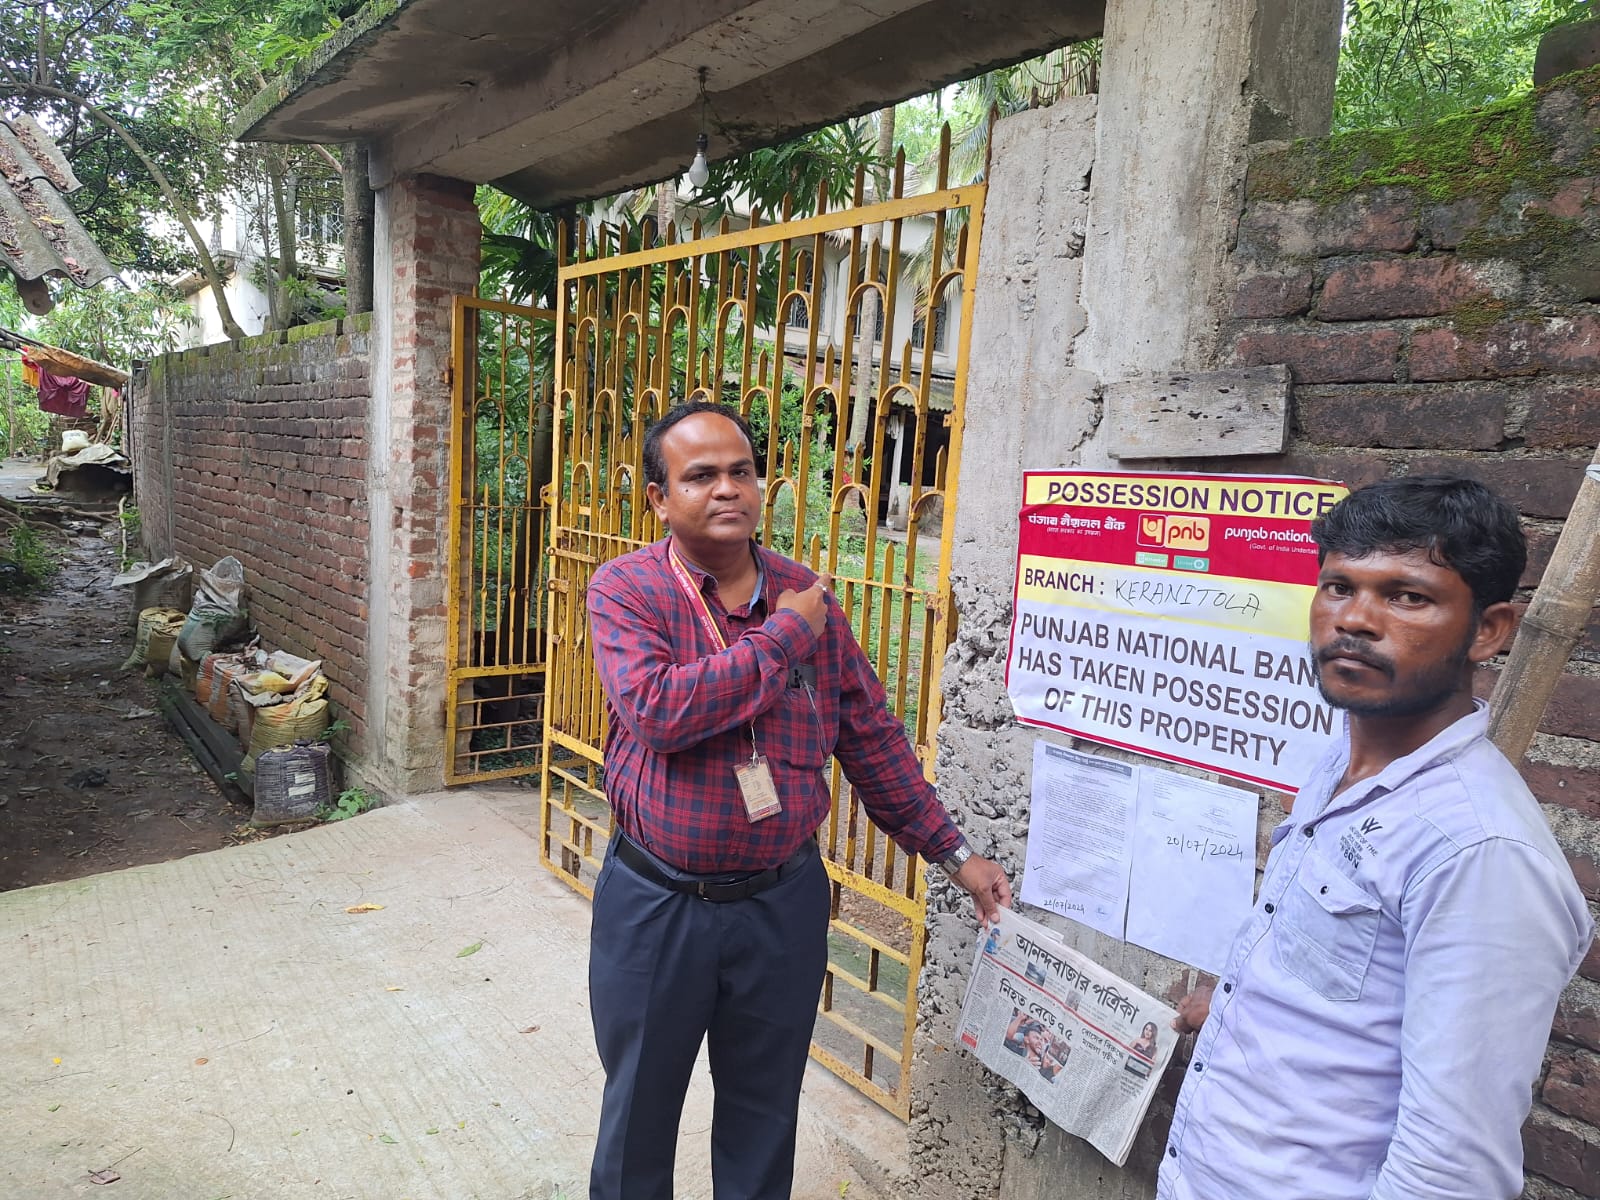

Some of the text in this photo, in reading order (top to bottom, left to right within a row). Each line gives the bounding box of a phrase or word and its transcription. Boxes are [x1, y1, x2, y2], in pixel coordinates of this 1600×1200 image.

[1048, 481, 1335, 516] POSSESSION NOTICE
[1028, 512, 1126, 531] पंजाब नैशनल बैंक
[1167, 520, 1205, 545] pnb
[1224, 526, 1316, 543] punjab nation
[1024, 568, 1094, 594] BRANCH
[1115, 578, 1263, 618] KERANITOLA
[1021, 612, 1316, 688] PUNJAB NATIONAL BAN
[1018, 647, 1334, 736] HAS TAKEN POSSESSION
[1044, 687, 1075, 712] OF
[1081, 694, 1132, 729] THIS
[1140, 708, 1287, 766] PROPERTY
[1166, 834, 1243, 863] 20/07/2024
[999, 978, 1027, 1008] নিহত
[1015, 932, 1091, 993] আনন্দবাজার
[1092, 981, 1140, 1024] পত্রিকা
